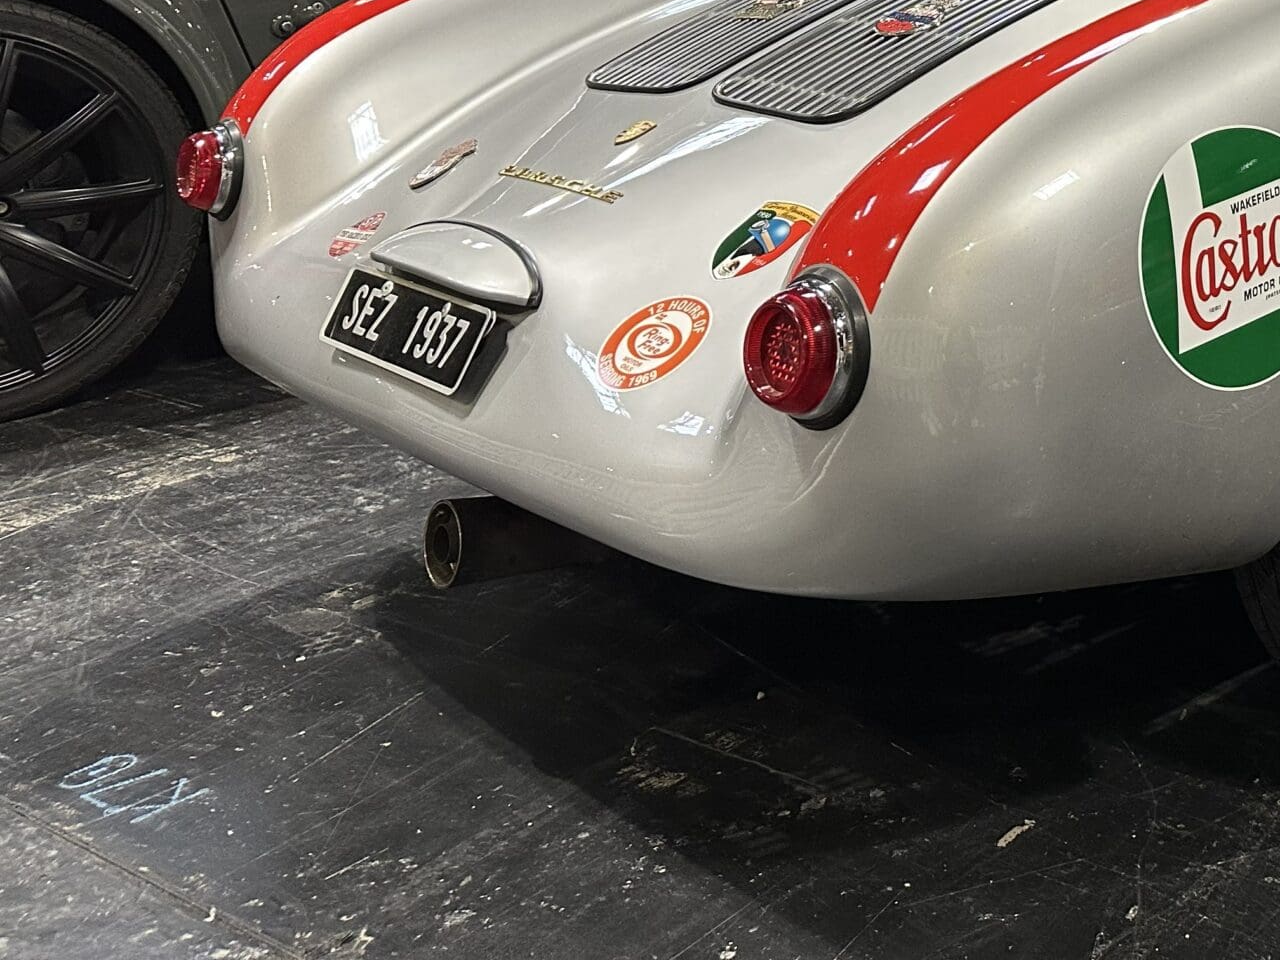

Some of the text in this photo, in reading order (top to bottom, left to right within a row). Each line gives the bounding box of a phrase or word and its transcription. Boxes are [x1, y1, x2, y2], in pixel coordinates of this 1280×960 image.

[1230, 185, 1280, 215] WAKEFIELD
[1243, 277, 1276, 302] MOTOR
[342, 284, 471, 369] SEZ 1937
[648, 299, 707, 334] 12 HOURS OF
[637, 340, 661, 355] Free
[600, 352, 658, 388] SEBRING 1969
